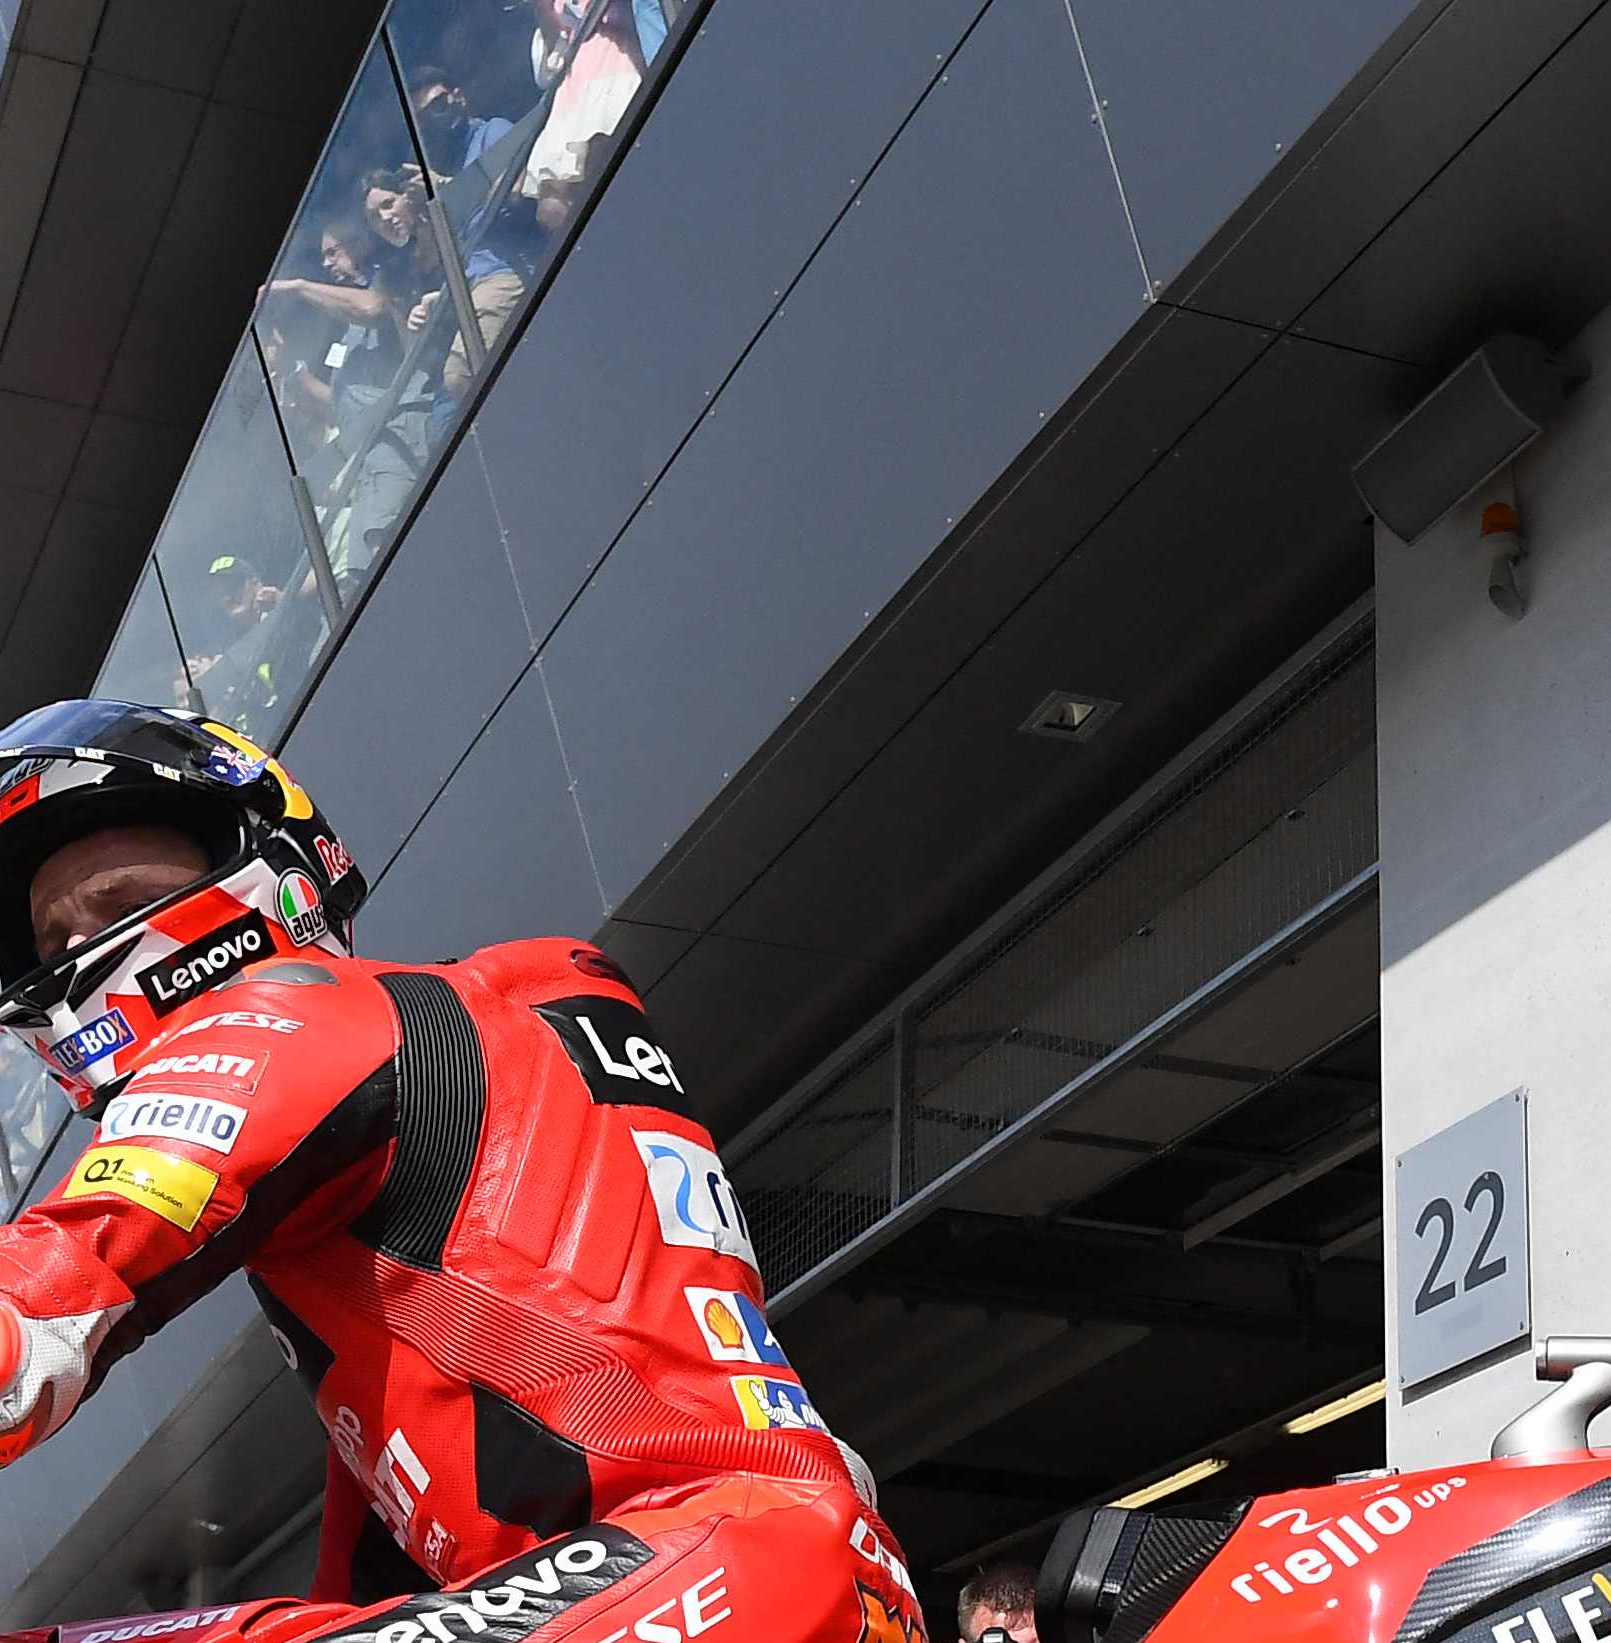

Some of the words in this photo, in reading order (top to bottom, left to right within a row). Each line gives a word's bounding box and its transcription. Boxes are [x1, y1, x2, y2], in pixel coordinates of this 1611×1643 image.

[151, 926, 263, 1001] Lenovo
[131, 1099, 236, 1141] riello
[84, 1158, 124, 1183] Q1
[1414, 1171, 1507, 1316] 22
[1230, 1496, 1412, 1603] riello
